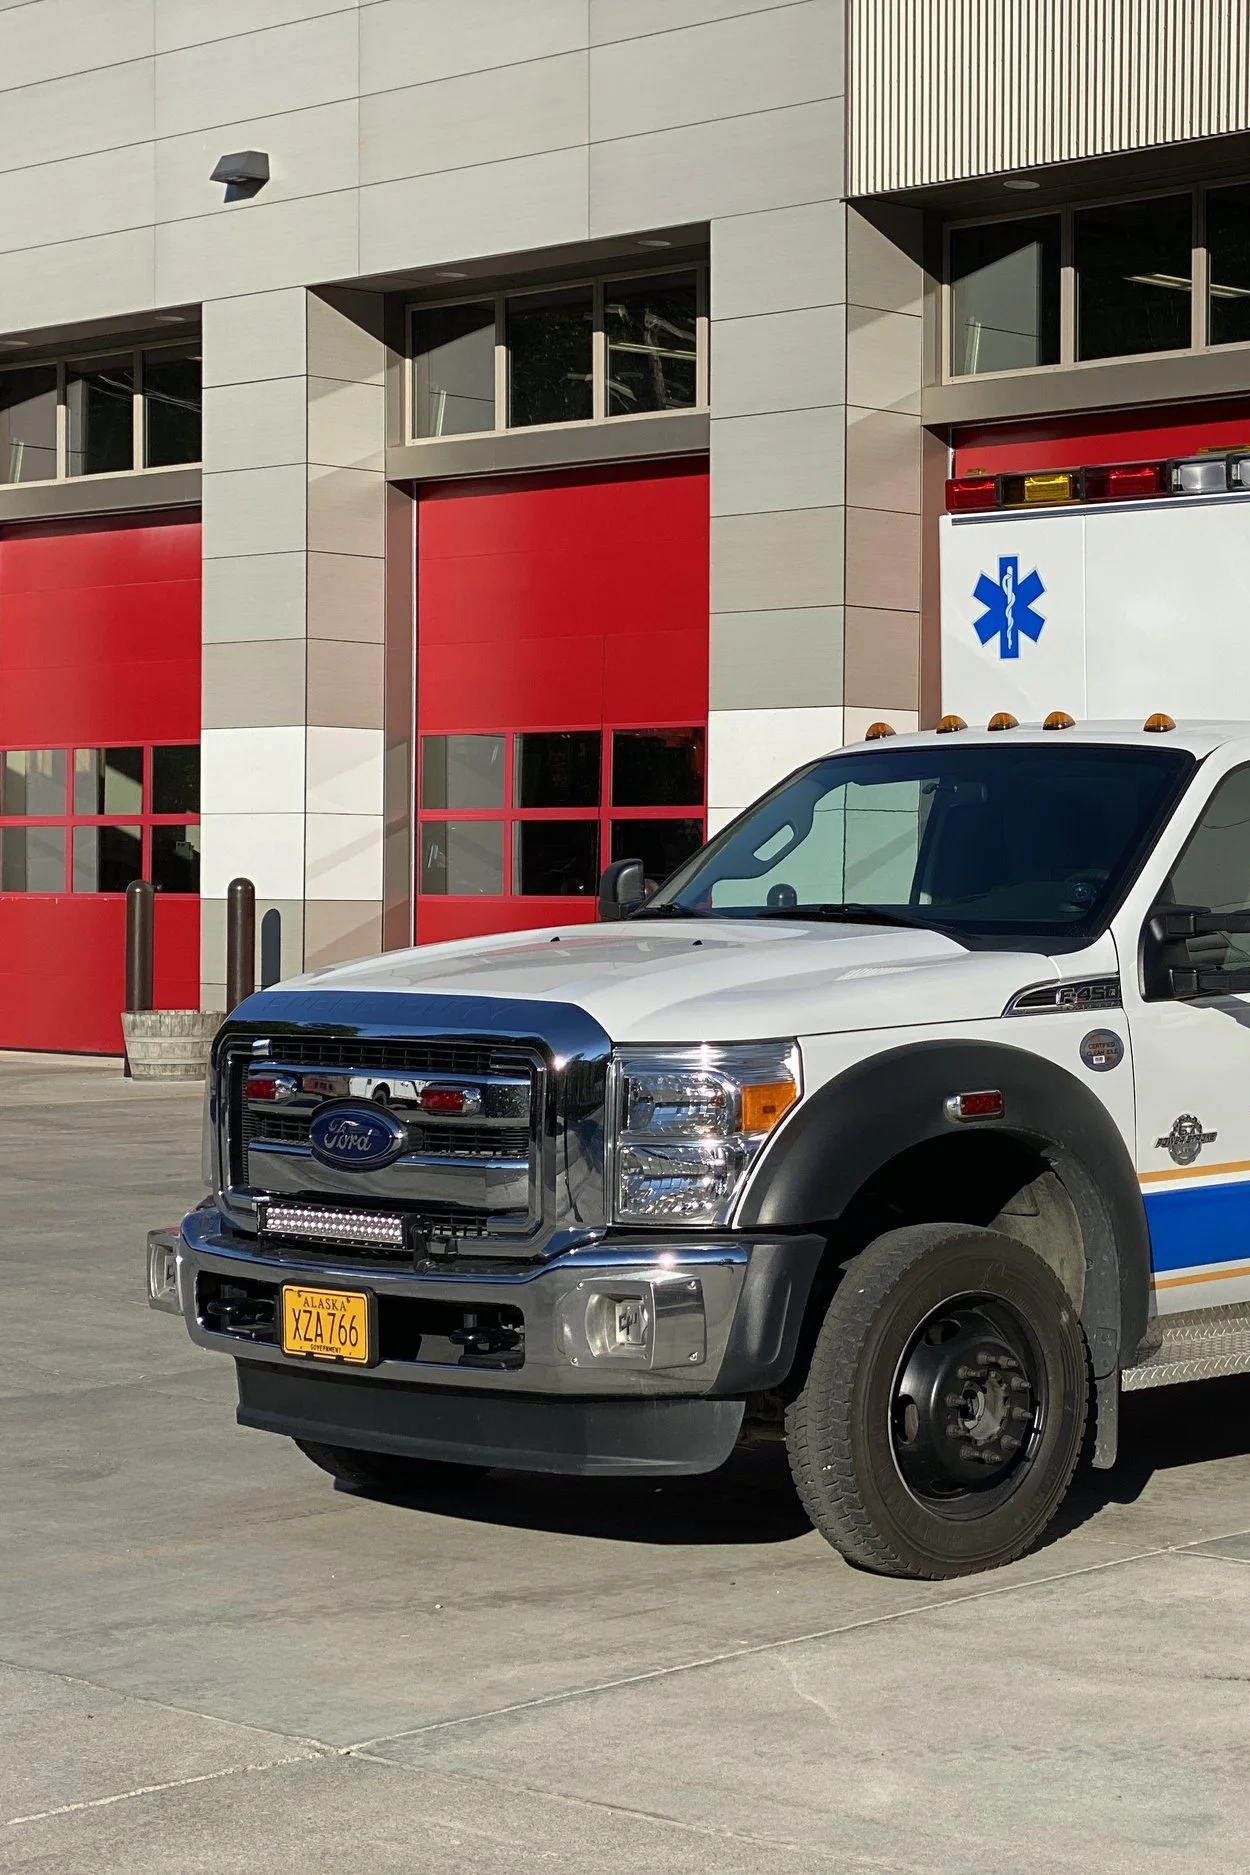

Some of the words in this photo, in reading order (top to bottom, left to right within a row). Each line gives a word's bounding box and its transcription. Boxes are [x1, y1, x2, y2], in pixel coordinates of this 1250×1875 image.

[1056, 985, 1120, 1005] F-450
[1088, 1041, 1116, 1049] CERTIFIED
[323, 1118, 374, 1152] Ford
[1156, 1134, 1185, 1148] POWER
[1186, 1132, 1217, 1144] STROKE
[303, 1296, 347, 1312] ALASKA
[310, 1343, 342, 1353] GOVERNMENT
